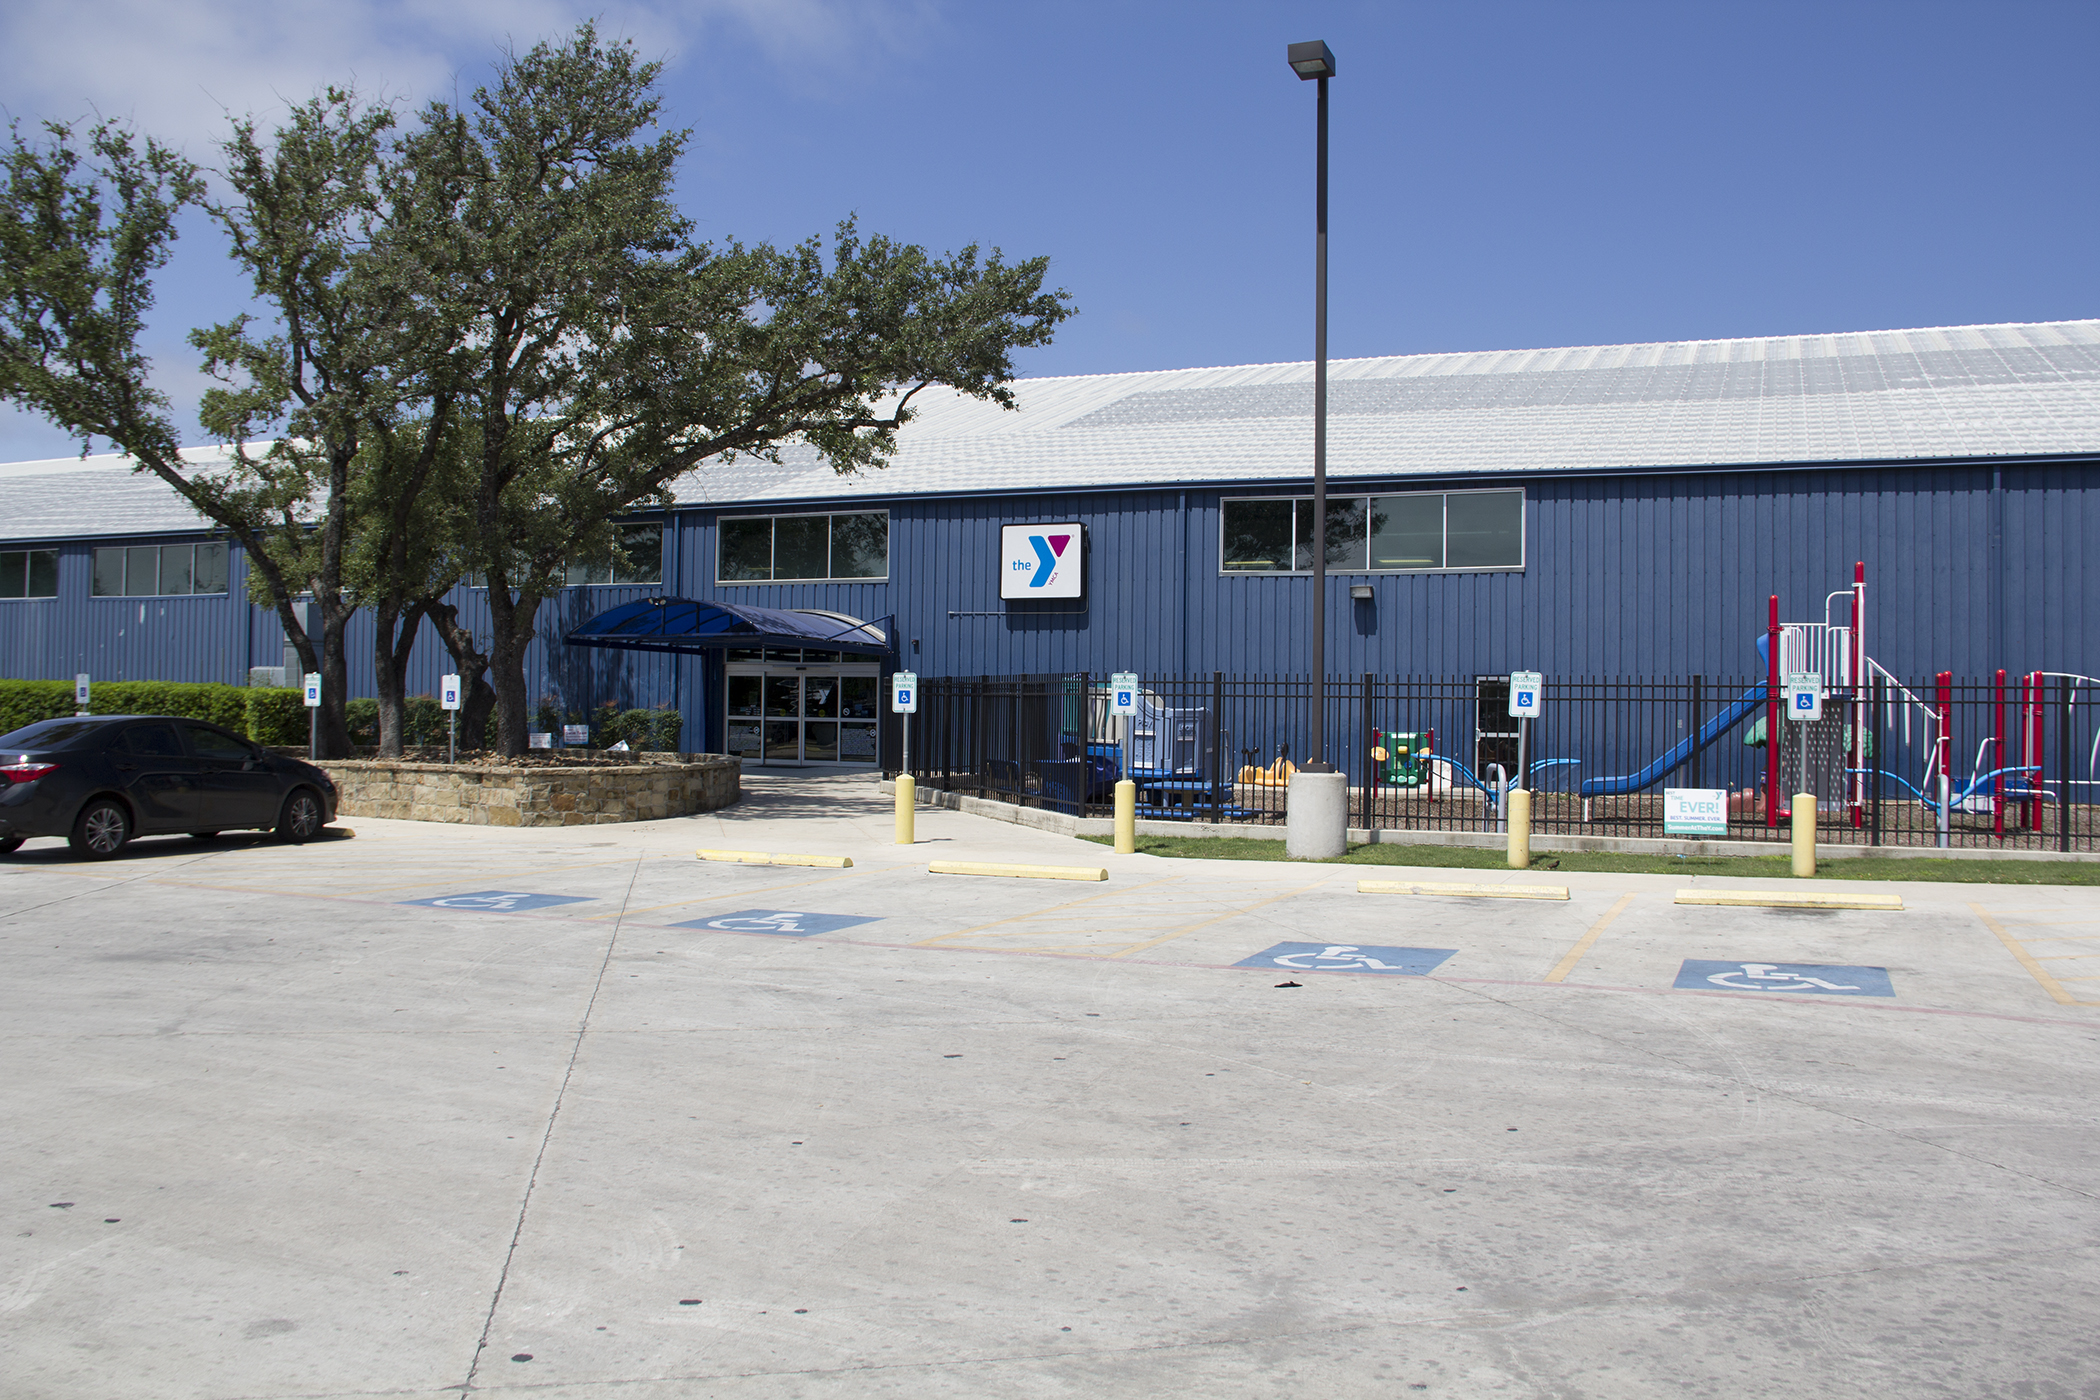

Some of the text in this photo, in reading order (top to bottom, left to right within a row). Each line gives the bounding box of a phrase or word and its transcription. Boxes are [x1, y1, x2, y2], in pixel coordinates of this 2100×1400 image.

[1012, 559, 1032, 571] the
[1048, 571, 1059, 586] YMCA
[1680, 801, 1719, 814] EVER!
